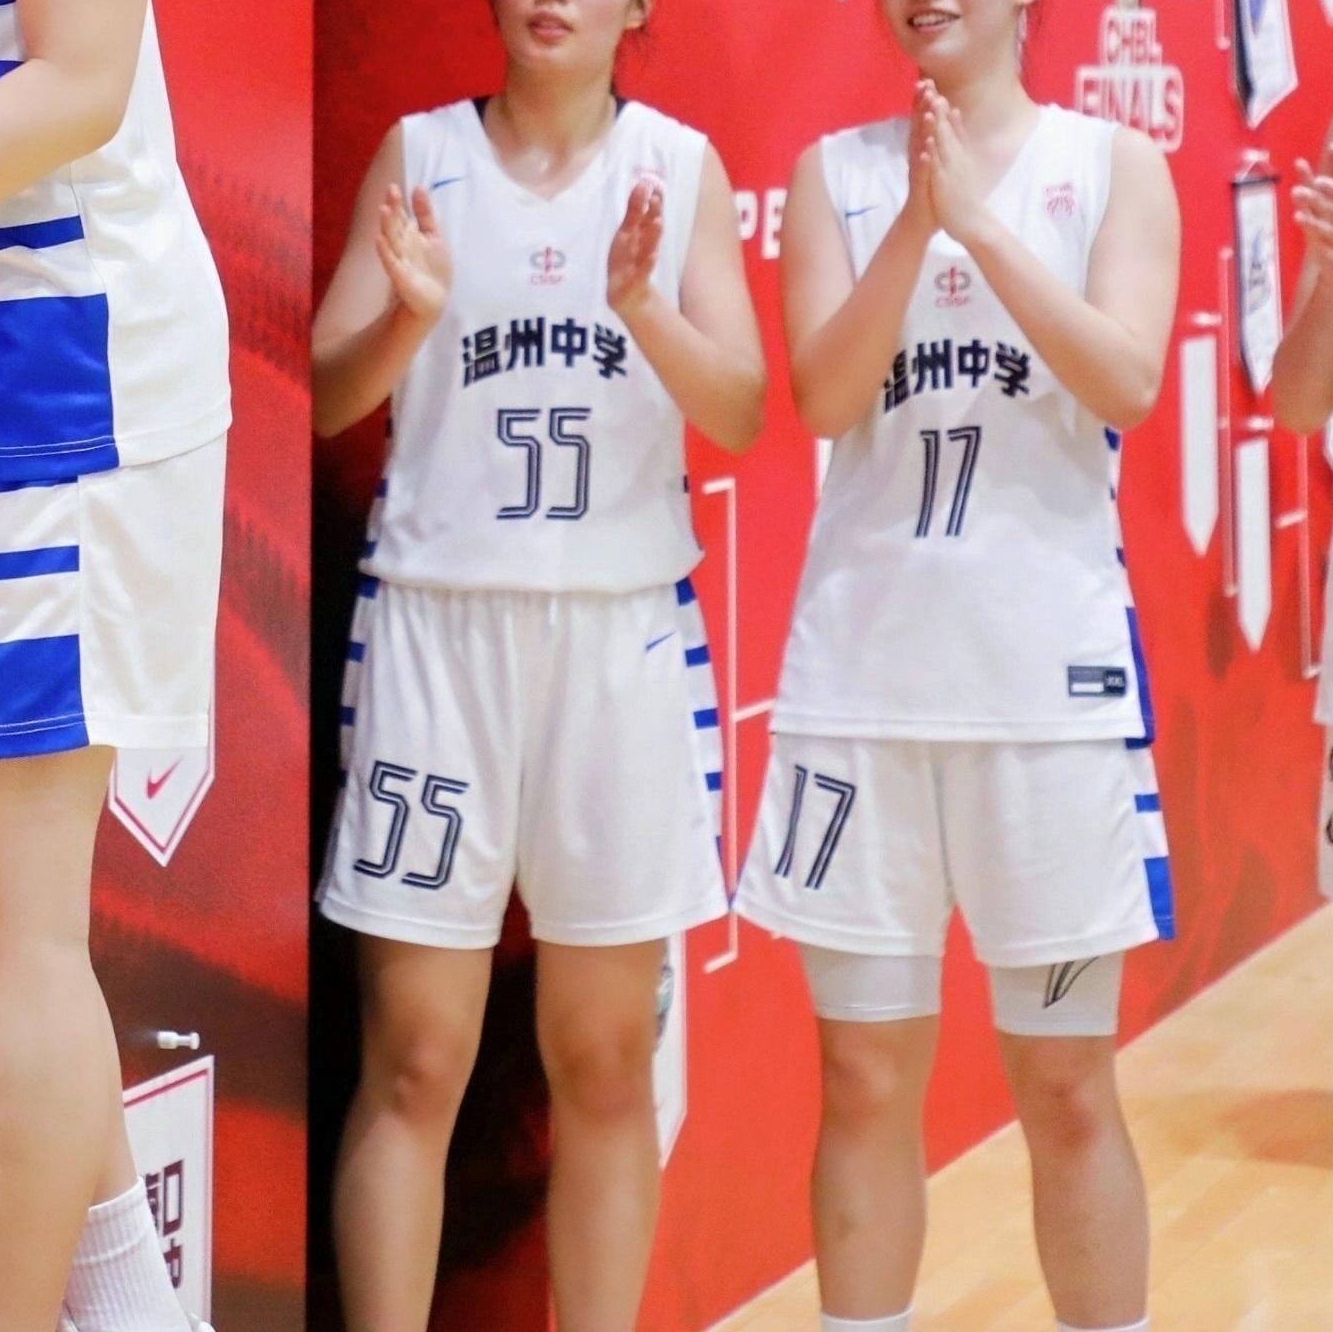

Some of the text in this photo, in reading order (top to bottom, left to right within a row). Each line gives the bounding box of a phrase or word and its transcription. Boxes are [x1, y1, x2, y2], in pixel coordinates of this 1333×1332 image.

[1104, 16, 1162, 64] CHBL
[1079, 71, 1183, 149] FINALS
[461, 316, 628, 388] 温州中学
[882, 339, 1031, 414] 温州中学
[496, 407, 592, 521] 55
[914, 425, 983, 539] 17
[353, 760, 471, 891] 55
[773, 764, 858, 892] 17
